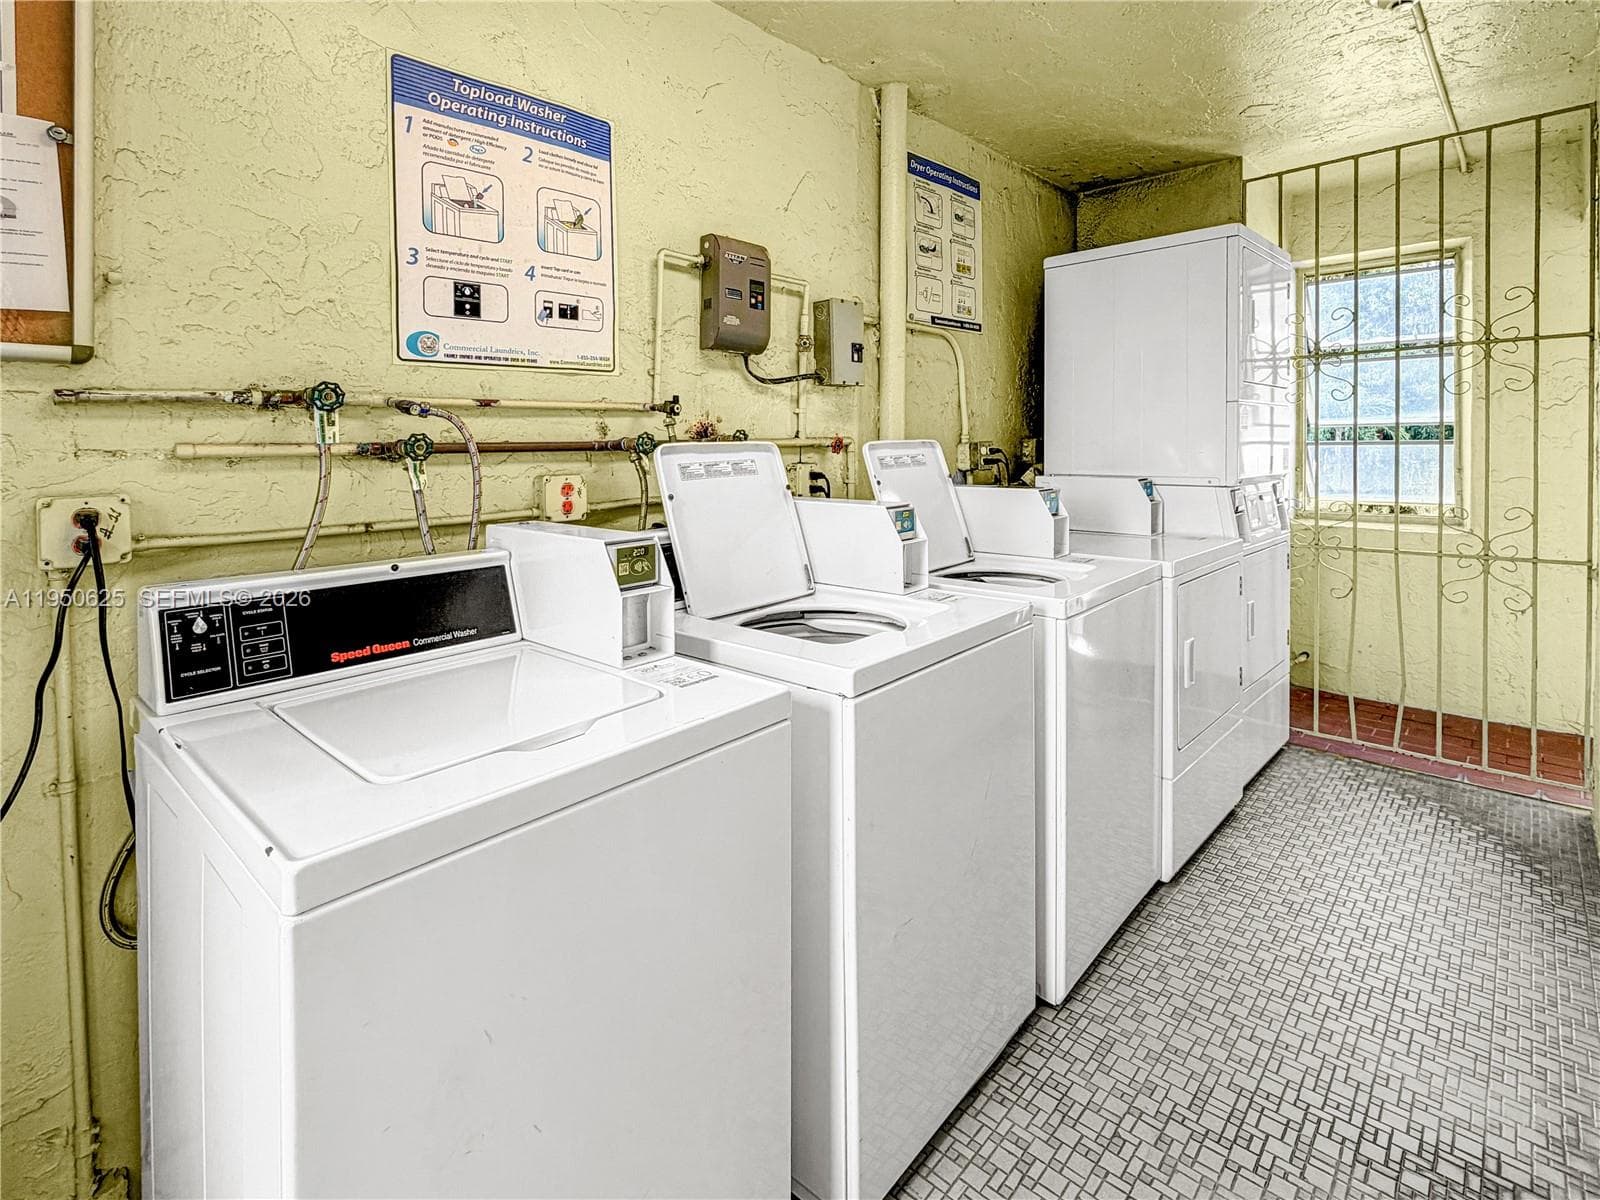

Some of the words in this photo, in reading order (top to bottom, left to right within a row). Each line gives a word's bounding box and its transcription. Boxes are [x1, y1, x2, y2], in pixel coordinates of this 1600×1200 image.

[453, 79, 514, 107] Topload
[515, 98, 567, 123] Washer
[405, 116, 413, 133] 1
[428, 92, 508, 127] Operating
[510, 114, 588, 148] Instructions
[433, 122, 465, 134] manufacturer
[466, 130, 499, 142] recommended
[448, 132, 471, 142] detergent
[486, 142, 507, 151] Efficiency
[522, 146, 533, 163] 2
[910, 160, 926, 172] Dryer
[926, 166, 952, 184] Operating
[952, 176, 978, 193] Instructions
[406, 247, 419, 265] 3
[440, 250, 469, 259] temperature
[524, 266, 536, 281] 4
[444, 343, 488, 352] Commercial
[490, 346, 526, 356] Laundries,
[331, 646, 370, 663] Speed
[372, 639, 411, 654] Queen
[412, 631, 452, 647] Commercial
[453, 627, 477, 639] Washer
